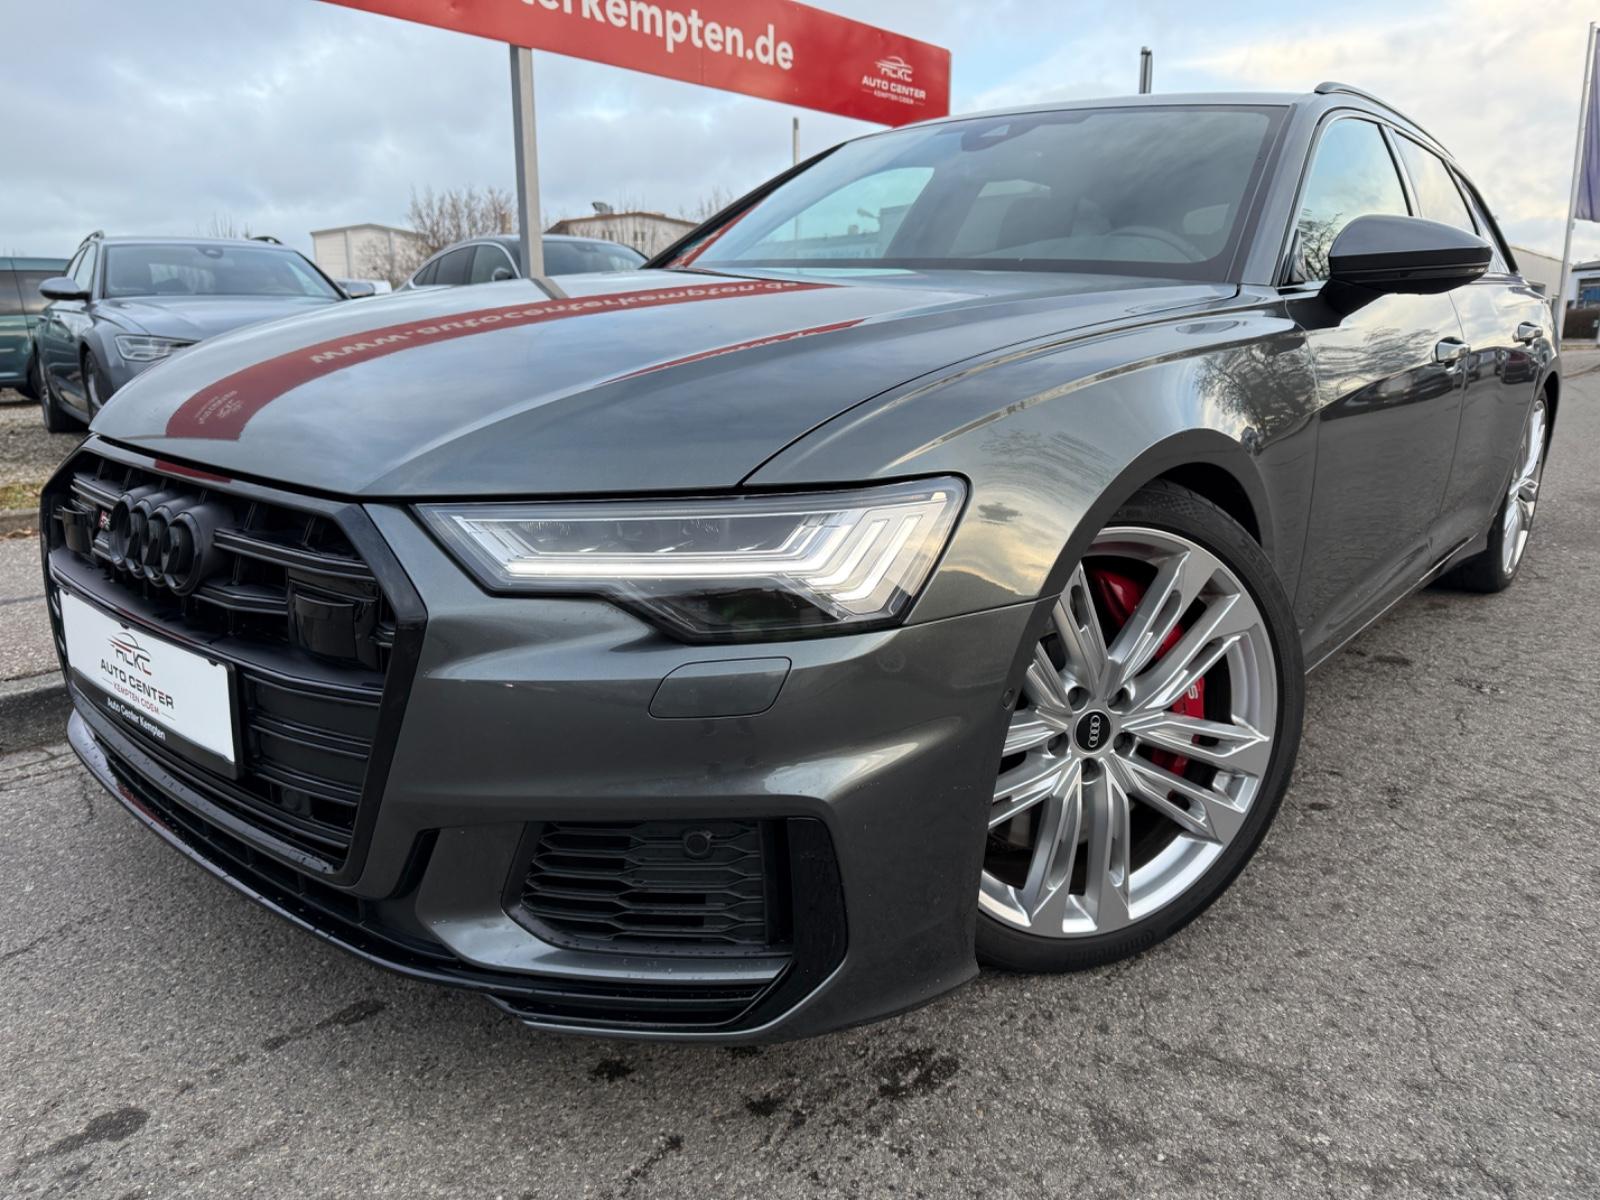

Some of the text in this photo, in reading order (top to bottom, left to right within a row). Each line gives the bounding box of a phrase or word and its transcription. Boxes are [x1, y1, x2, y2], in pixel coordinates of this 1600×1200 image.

[862, 75, 889, 90] AUTO
[890, 82, 926, 100] CENTER
[101, 658, 174, 709] AUTO CENTER
[113, 682, 140, 704] KEMPTEN
[107, 697, 166, 740] Auto Center Kempten
